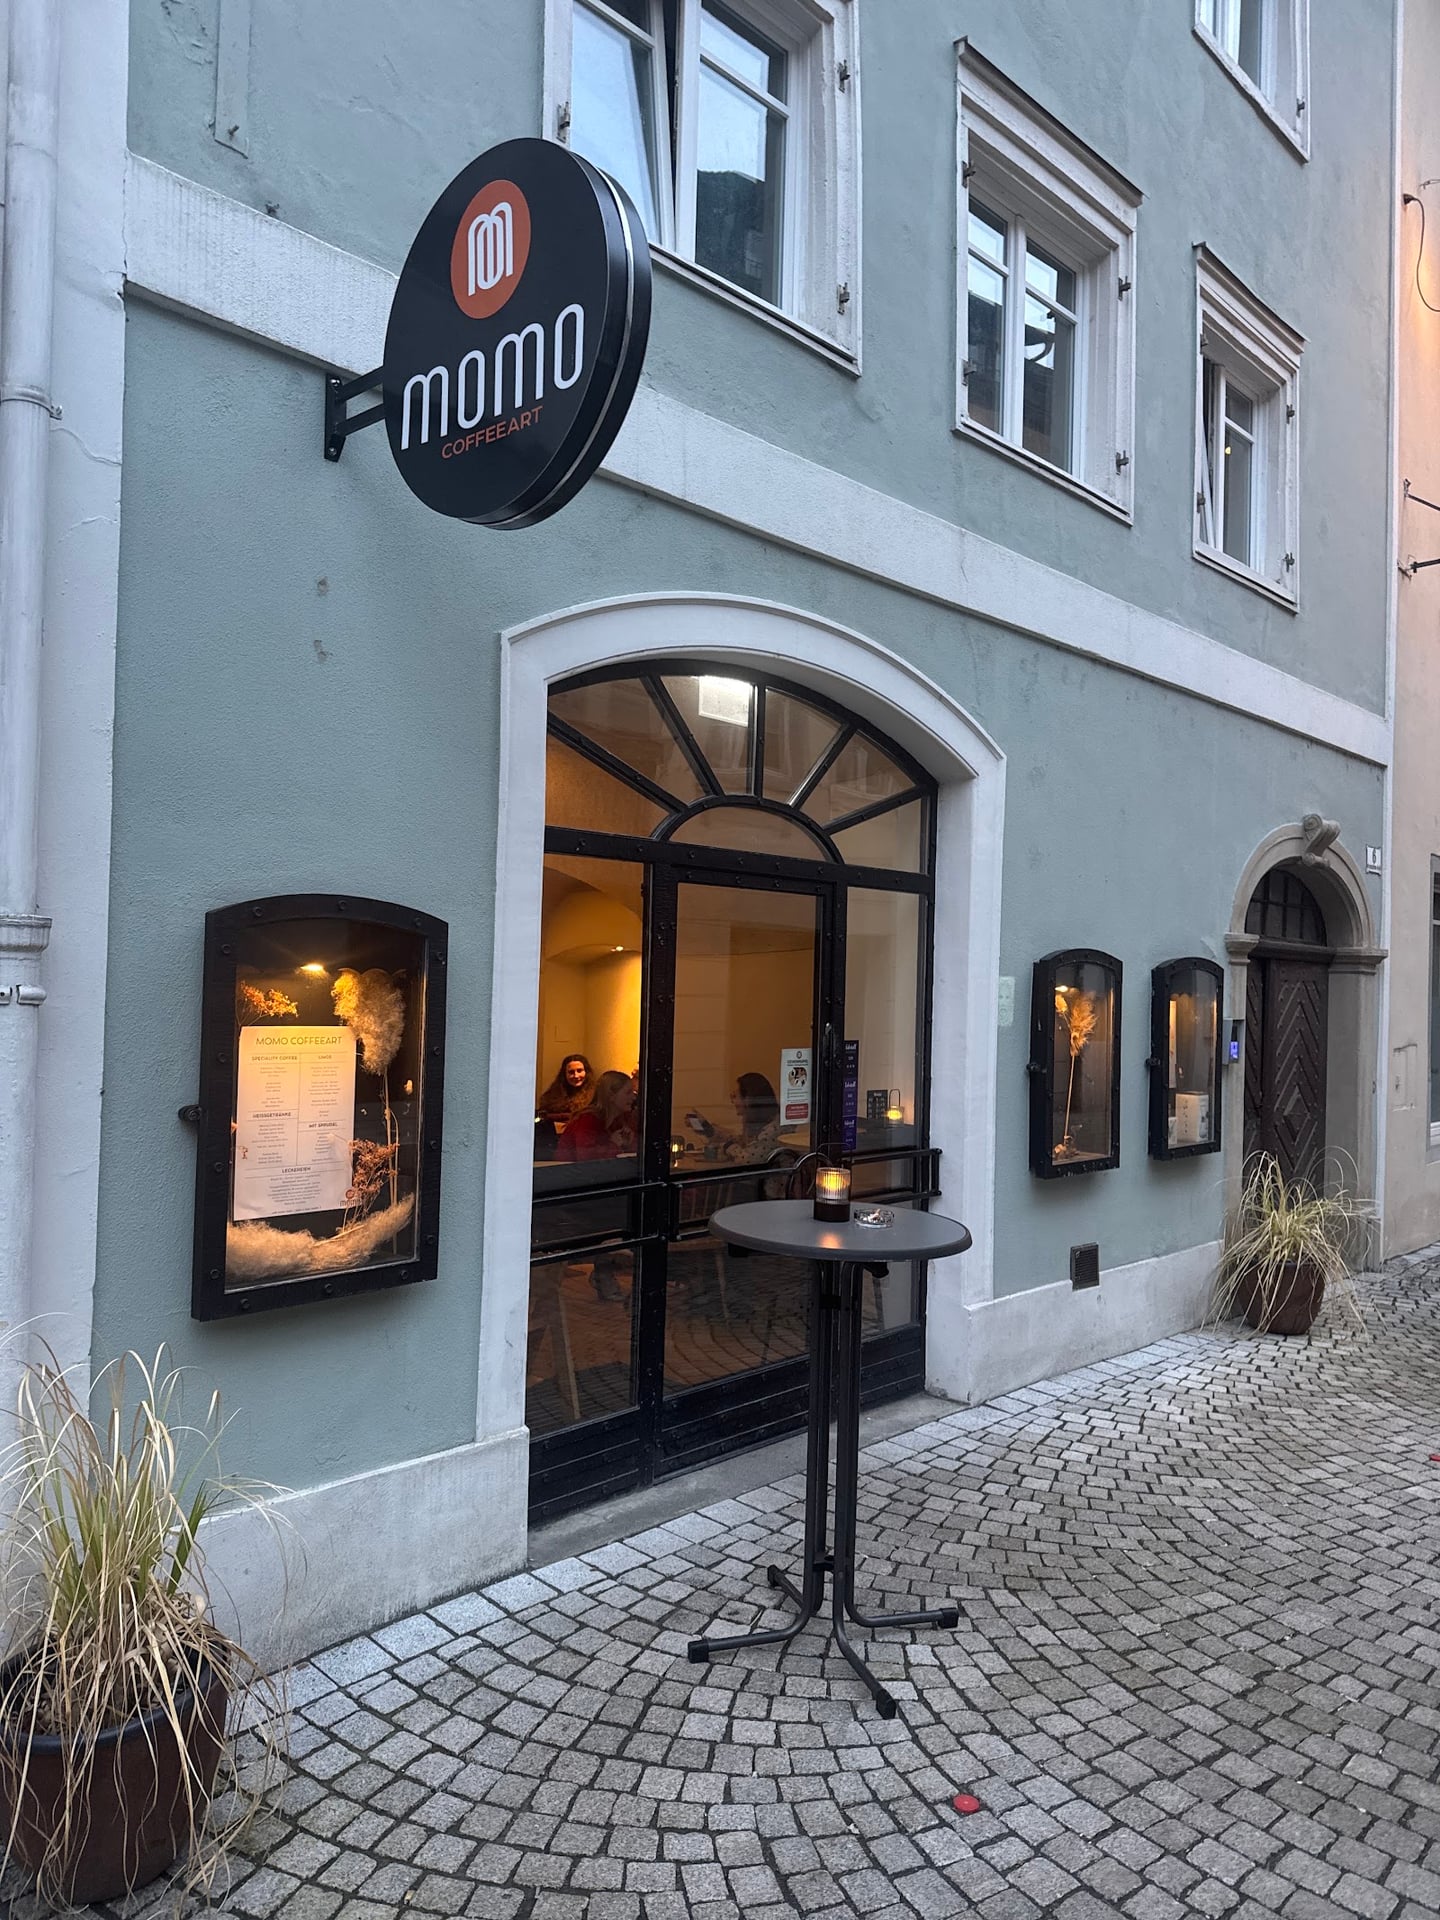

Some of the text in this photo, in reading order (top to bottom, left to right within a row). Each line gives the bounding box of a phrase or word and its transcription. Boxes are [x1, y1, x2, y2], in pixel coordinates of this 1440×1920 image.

[441, 405, 543, 460] COFFEEART
[256, 1036, 342, 1045] MOMO COFFEEART
